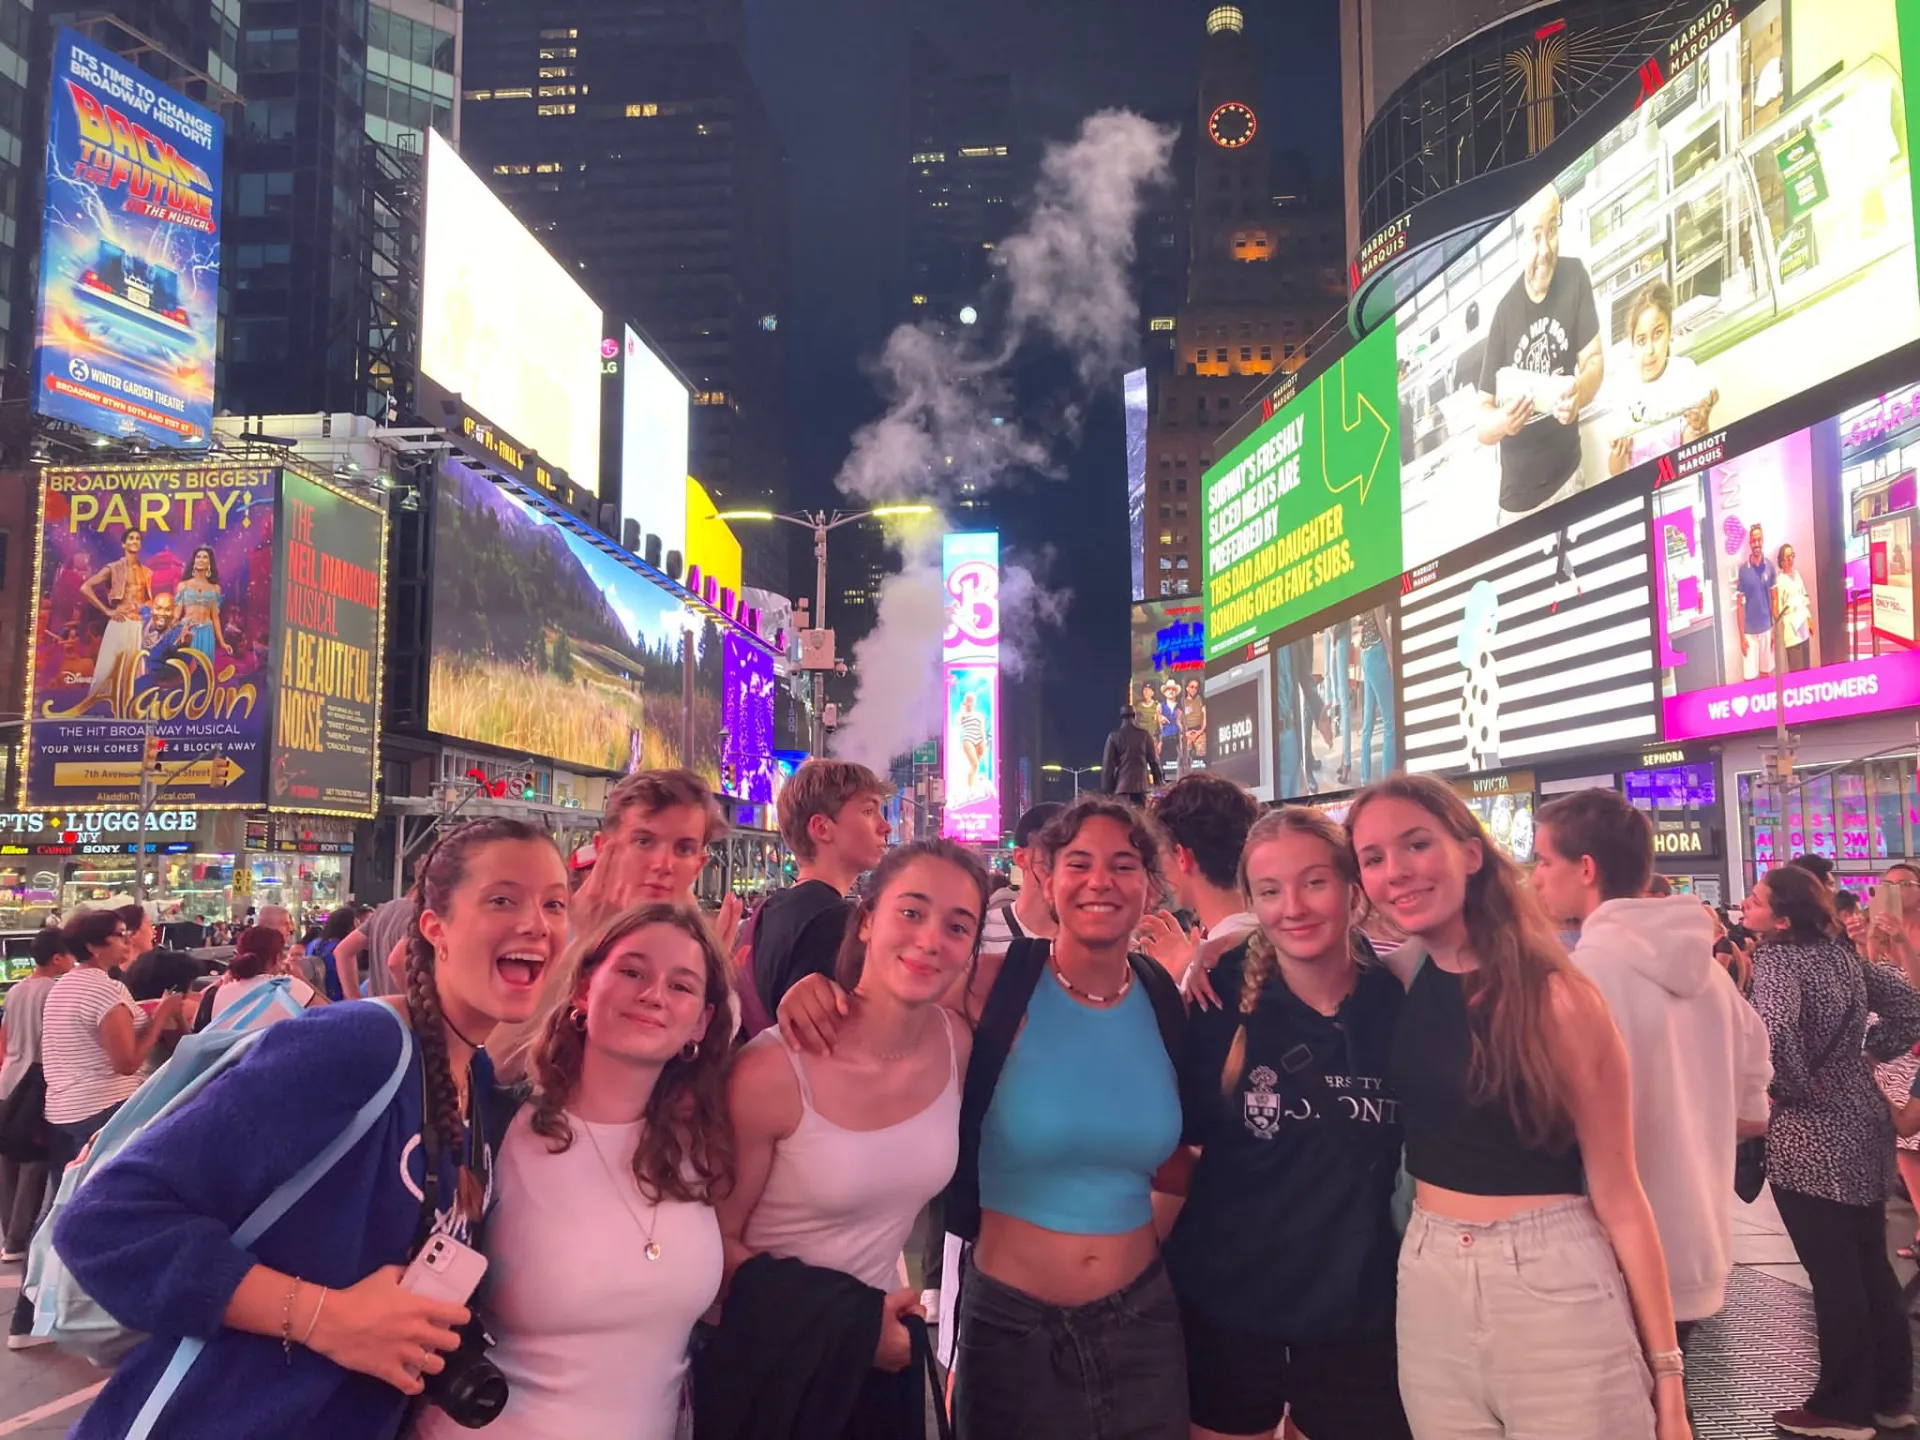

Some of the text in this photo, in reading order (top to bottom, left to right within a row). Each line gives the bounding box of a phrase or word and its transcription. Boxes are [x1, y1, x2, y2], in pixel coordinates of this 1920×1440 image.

[1670, 0, 1731, 56] MARRIOT
[1671, 13, 1733, 75] MARQUIS
[70, 60, 212, 150] BROADWAY HISTORY!
[71, 45, 213, 136] IT'S TIME TO CHANGE
[79, 139, 111, 171] TO
[108, 155, 213, 220] FUTURE
[144, 204, 211, 232] THE MUSICAL
[1361, 214, 1411, 262] MARRIOTT
[1362, 236, 1404, 278] MARQUIS
[90, 367, 185, 412] WINTER GARDEN THEATRE
[600, 361, 618, 374] LG
[55, 380, 101, 403] BROADWAY
[102, 397, 126, 411] BTWN
[127, 404, 147, 419] 50TH
[148, 412, 163, 424] AND
[164, 417, 180, 429] 51ST
[1208, 412, 1304, 514] SUBWAY'S FRESHLY
[1678, 431, 1727, 461] MARRIOTT
[1678, 448, 1722, 473] MARQUIS
[50, 469, 272, 492] BROADWAY'S BIGGEST
[1209, 453, 1301, 545] SLICED MEATS ARE
[69, 490, 253, 533] PARTY!
[290, 498, 315, 546] THE
[1209, 504, 1279, 576] PREFERRED BY
[1210, 503, 1344, 607] THIS DAD AND DAUGHTER
[288, 539, 379, 611] NEIL DIAMOND
[623, 517, 763, 636] BROADWAY
[1210, 591, 1255, 639] BONDING
[1255, 575, 1284, 616] OVER
[1285, 558, 1314, 602] FAVE
[1314, 538, 1355, 587] SUBS.
[286, 580, 338, 637] MUSICAL
[41, 647, 257, 721] Aladdin
[281, 627, 371, 704] A BEAUTIFUL
[1707, 699, 1730, 720] WE
[1783, 673, 1879, 707] CUSTOMERS
[59, 724, 241, 737] THE HIT BROAWAY MUSICAL
[278, 688, 325, 753] NOISE
[1218, 718, 1253, 744] BIG BOLD
[41, 745, 69, 754] YOUR
[73, 744, 100, 754] WISH
[104, 744, 139, 754] COMES
[173, 743, 180, 752] 4
[183, 742, 224, 752] BLOCKS
[227, 742, 256, 752] AWAY
[1643, 750, 1684, 766] SEPHORA
[84, 769, 99, 779] 7th
[183, 769, 211, 778] Street
[1473, 775, 1510, 793] INVICTA
[58, 832, 101, 844] I NY
[66, 811, 197, 832] LUGGAGE
[0, 845, 29, 854] Nikon
[37, 846, 73, 854] Canon
[83, 845, 120, 854] SONY
[320, 844, 339, 852] SONY
[234, 870, 242, 892] ATM
